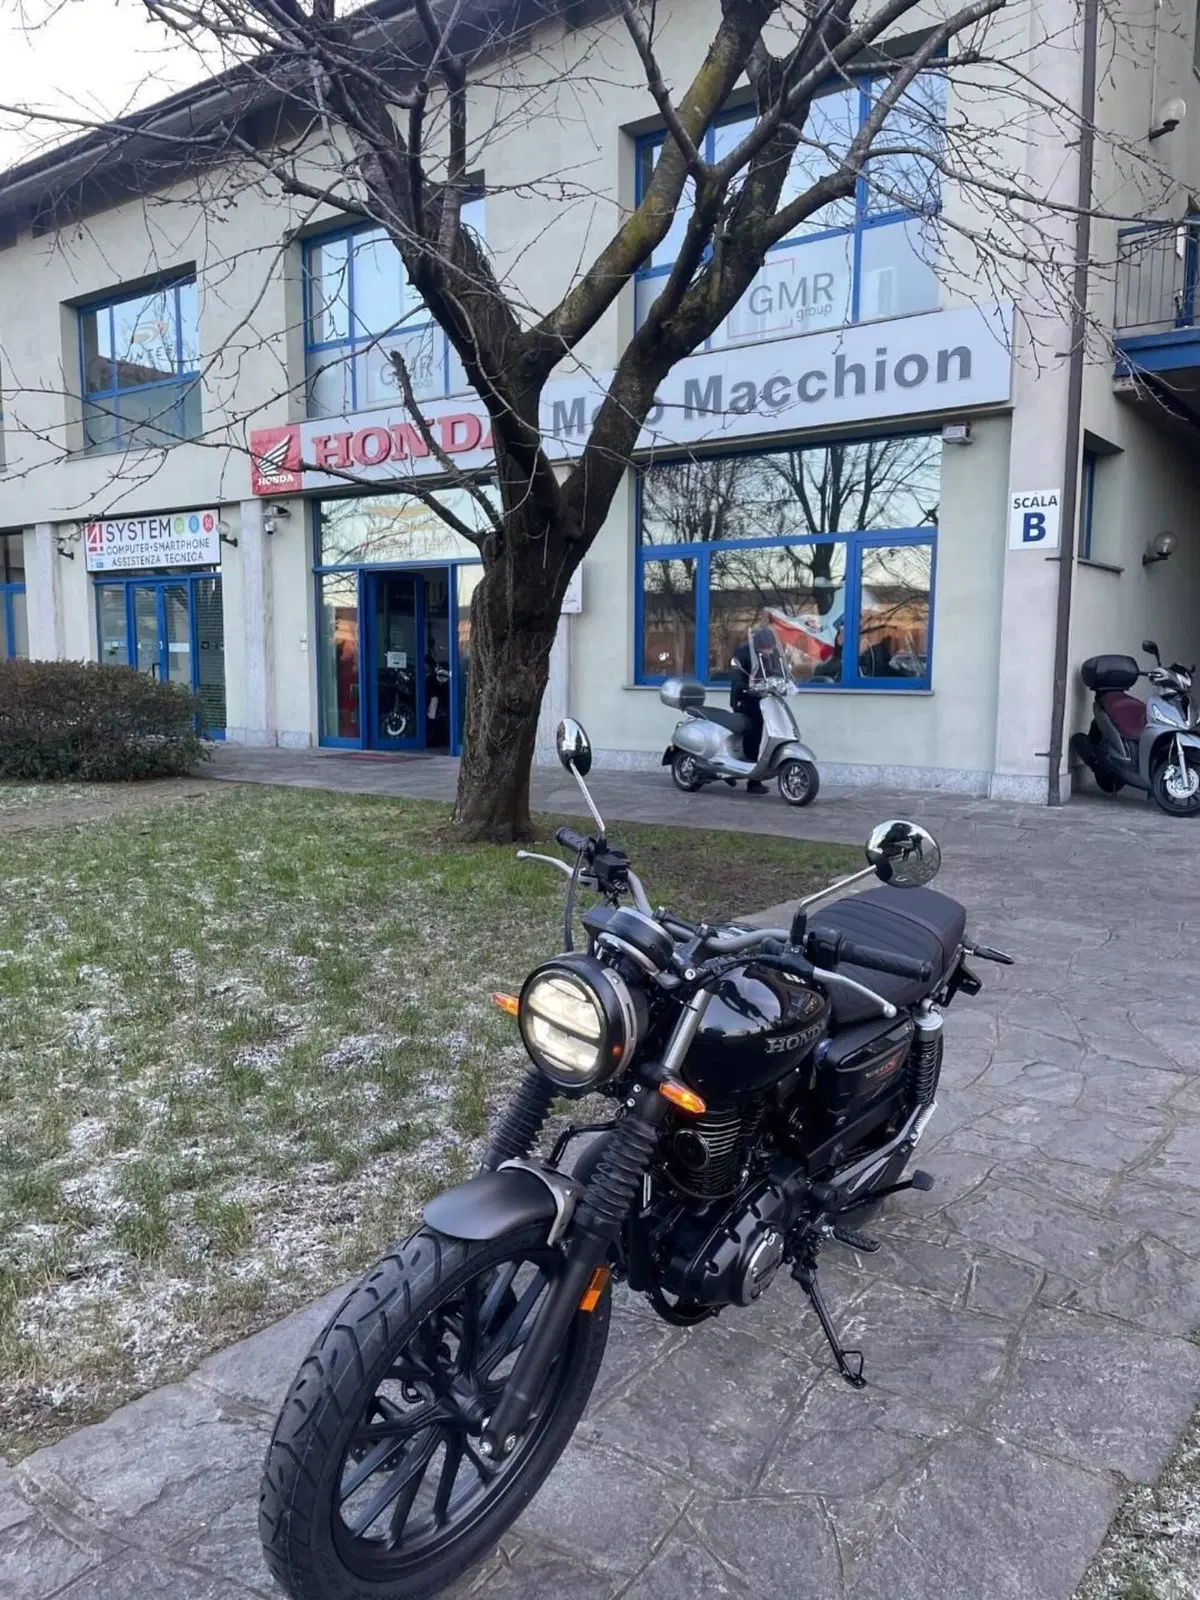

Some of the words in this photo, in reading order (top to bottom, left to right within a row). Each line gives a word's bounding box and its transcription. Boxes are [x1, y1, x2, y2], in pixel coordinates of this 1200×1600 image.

[750, 272, 834, 315] GMR
[796, 302, 832, 322] group
[684, 344, 972, 420] Macchion
[311, 412, 496, 469] HOND
[258, 473, 294, 486] HONDA
[1013, 495, 1058, 509] SCALA
[106, 517, 171, 542] SYSTEM
[1023, 512, 1046, 542] B
[112, 554, 160, 567] ASSISTENZA
[164, 551, 204, 563] TECNICA
